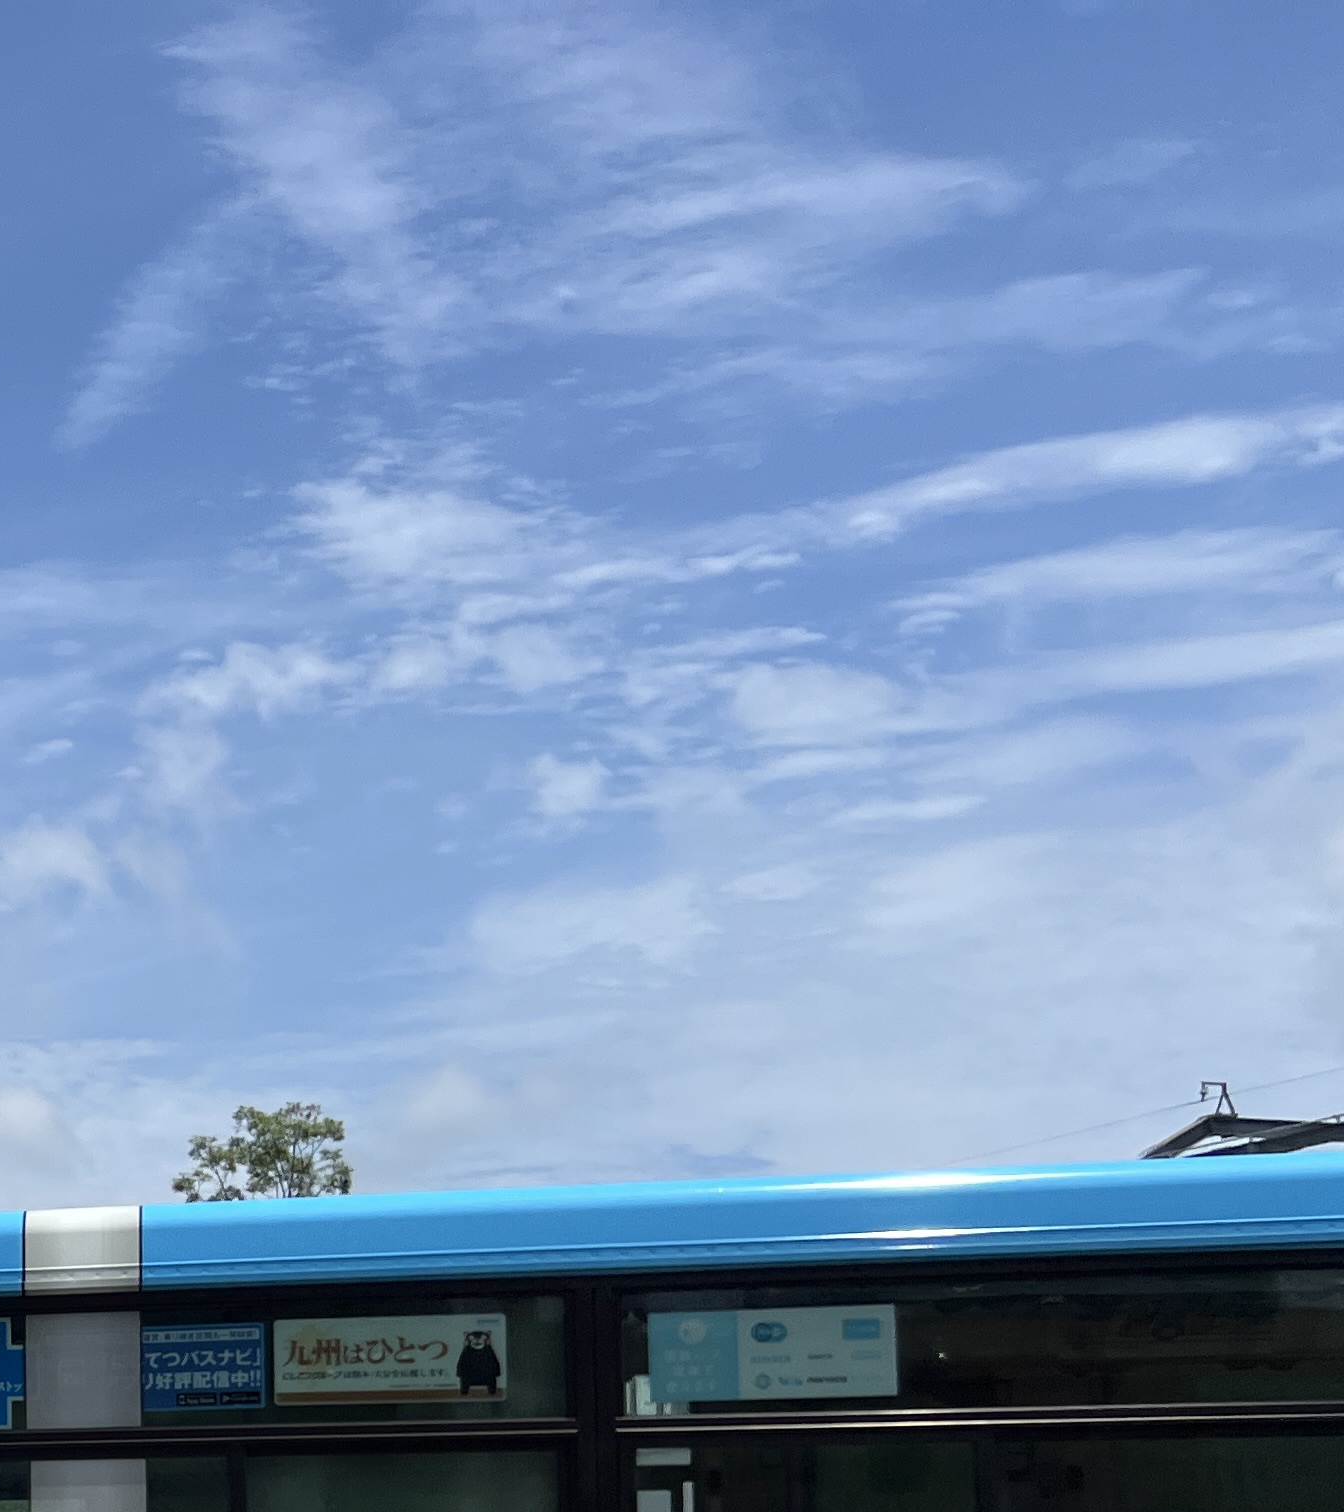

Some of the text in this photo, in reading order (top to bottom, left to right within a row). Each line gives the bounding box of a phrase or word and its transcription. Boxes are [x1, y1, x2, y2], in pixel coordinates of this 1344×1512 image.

[283, 1336, 449, 1367] 九州はひとつ
